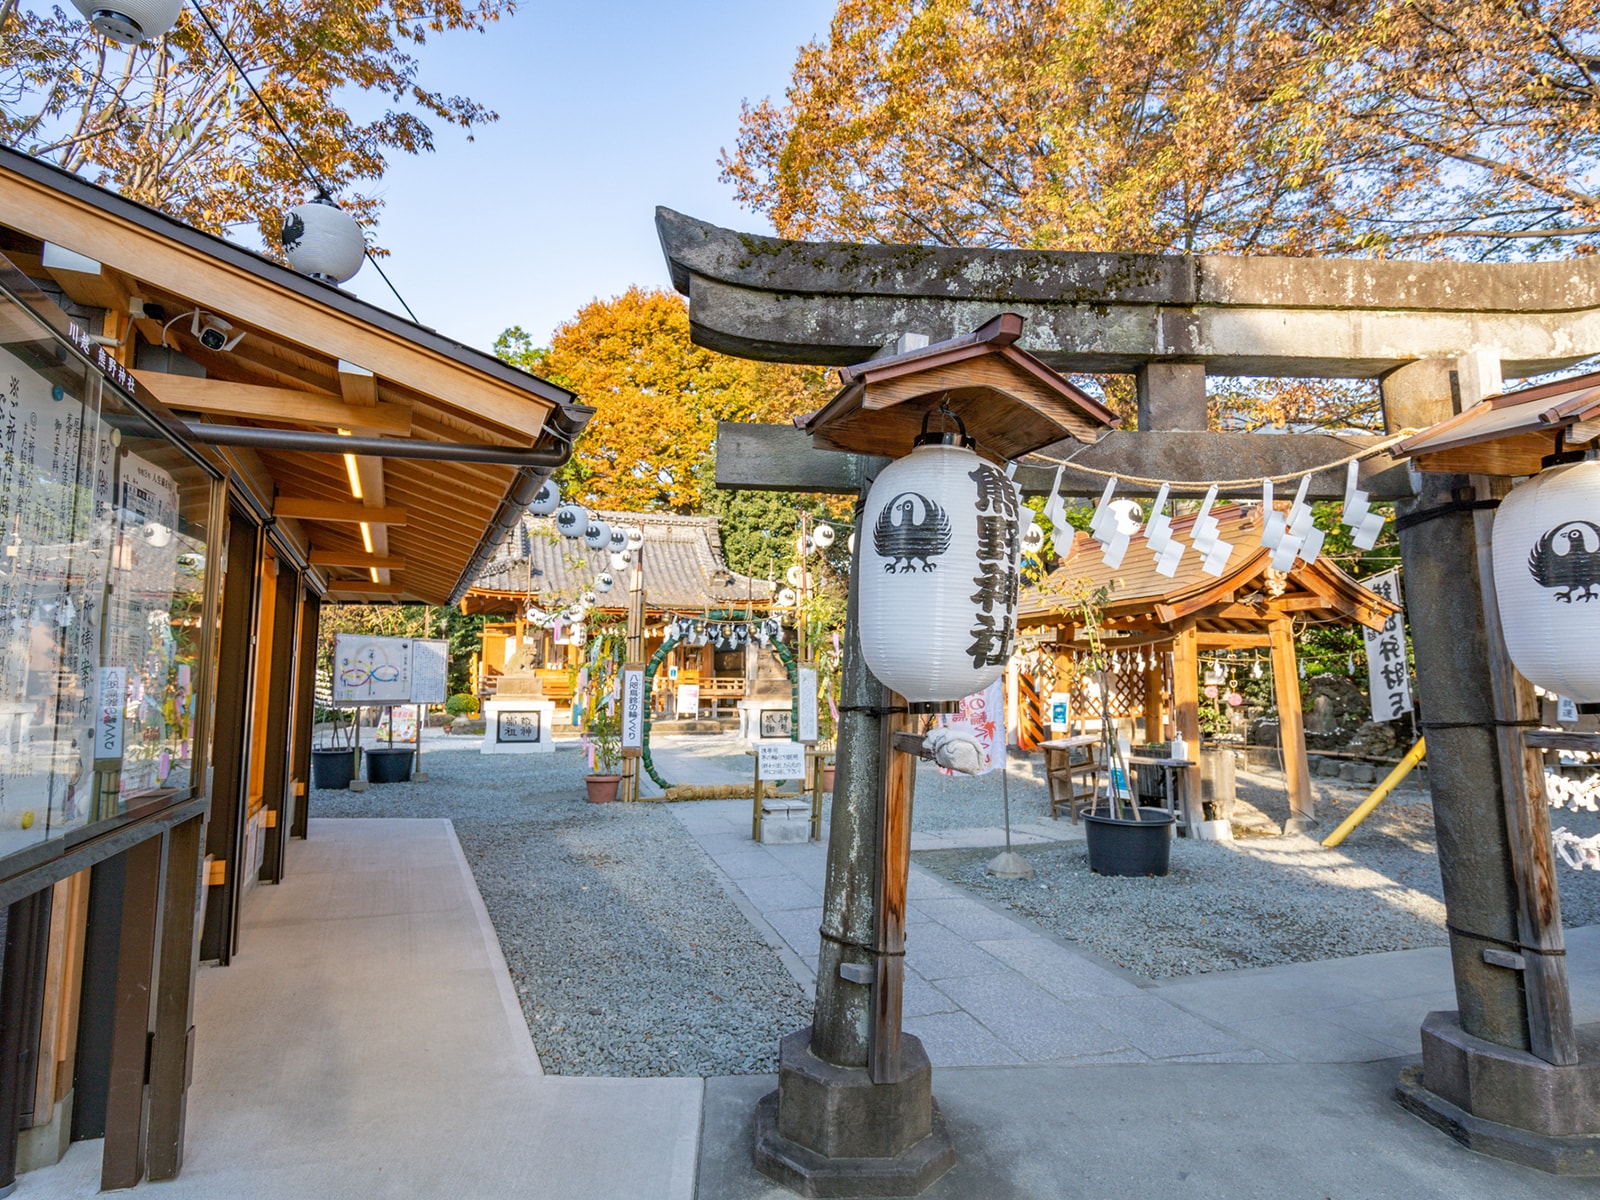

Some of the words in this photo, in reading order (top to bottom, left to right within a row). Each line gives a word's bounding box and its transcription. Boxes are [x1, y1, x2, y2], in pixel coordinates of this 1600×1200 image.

[68, 321, 90, 355] 川越
[97, 347, 136, 394] 熊野神社
[965, 463, 1020, 670] 熊野神社
[520, 716, 533, 737] 敬神
